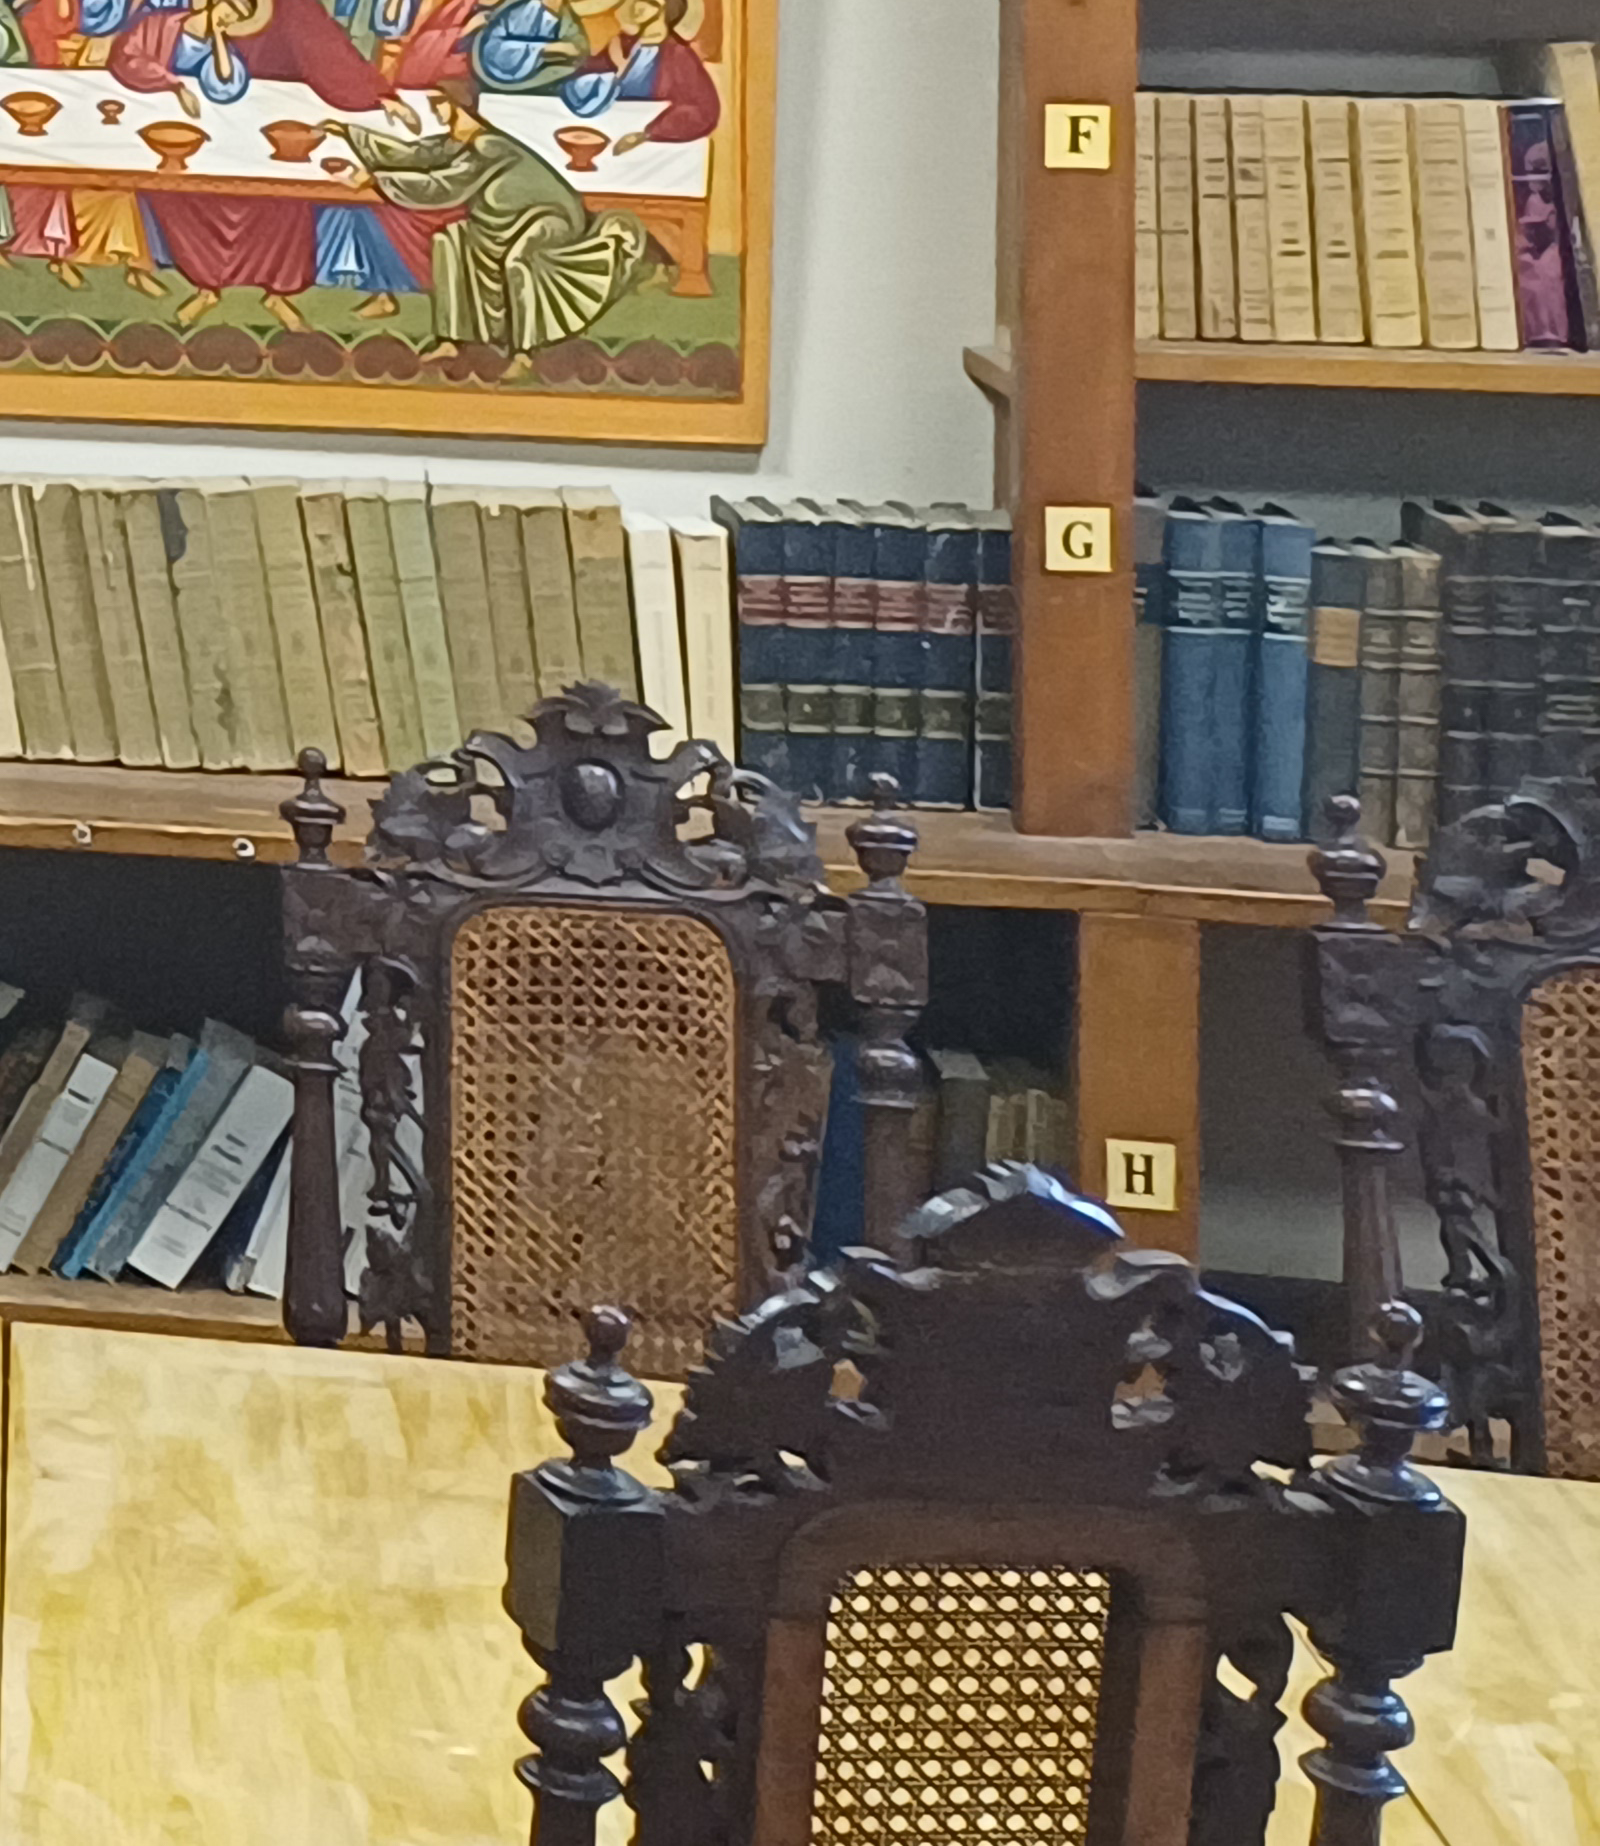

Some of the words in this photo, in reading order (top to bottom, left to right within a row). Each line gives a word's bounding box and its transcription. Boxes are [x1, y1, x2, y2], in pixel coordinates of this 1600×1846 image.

[1069, 116, 1098, 153] F
[1062, 522, 1092, 559] G
[1123, 1153, 1154, 1195] H
